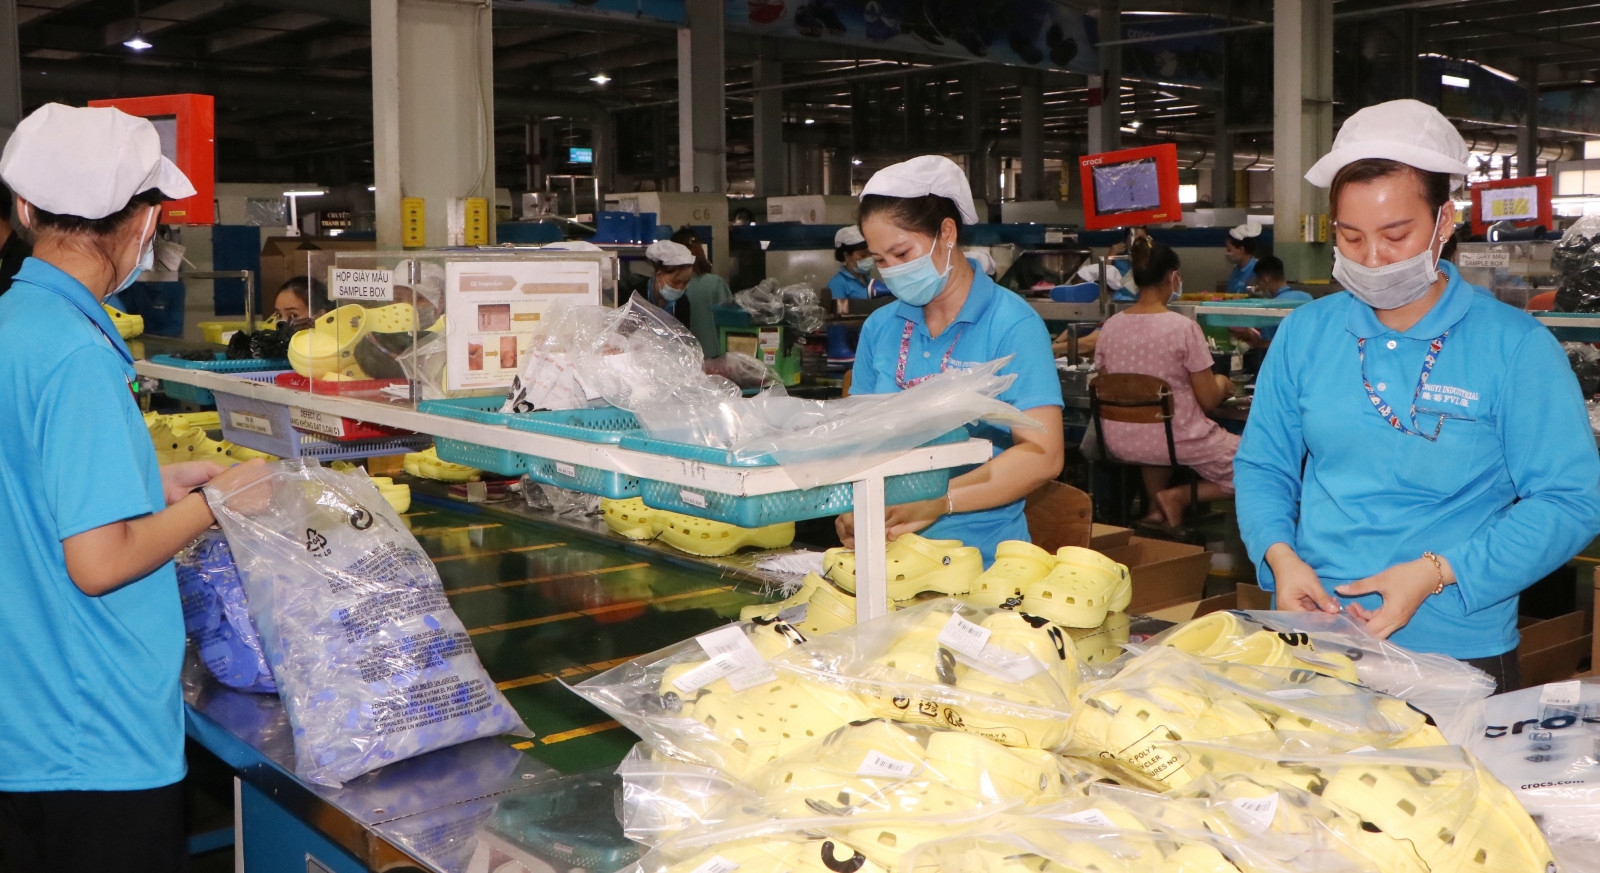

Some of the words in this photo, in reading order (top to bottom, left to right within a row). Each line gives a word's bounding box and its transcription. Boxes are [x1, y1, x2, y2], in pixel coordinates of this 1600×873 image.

[1082, 158, 1103, 167] crocs
[339, 286, 368, 297] SAMPLE
[369, 287, 386, 298] BOX
[424, 689, 439, 697] EVITAR
[446, 683, 464, 692] PELIGRO
[410, 700, 426, 708] BOLSA
[451, 689, 469, 698] ALCANCE
[409, 707, 426, 715] UTILICE
[1134, 747, 1152, 762] POLY
[1139, 754, 1163, 771] YCLER
[1148, 763, 1168, 777] URES
[1166, 756, 1178, 766] NO
